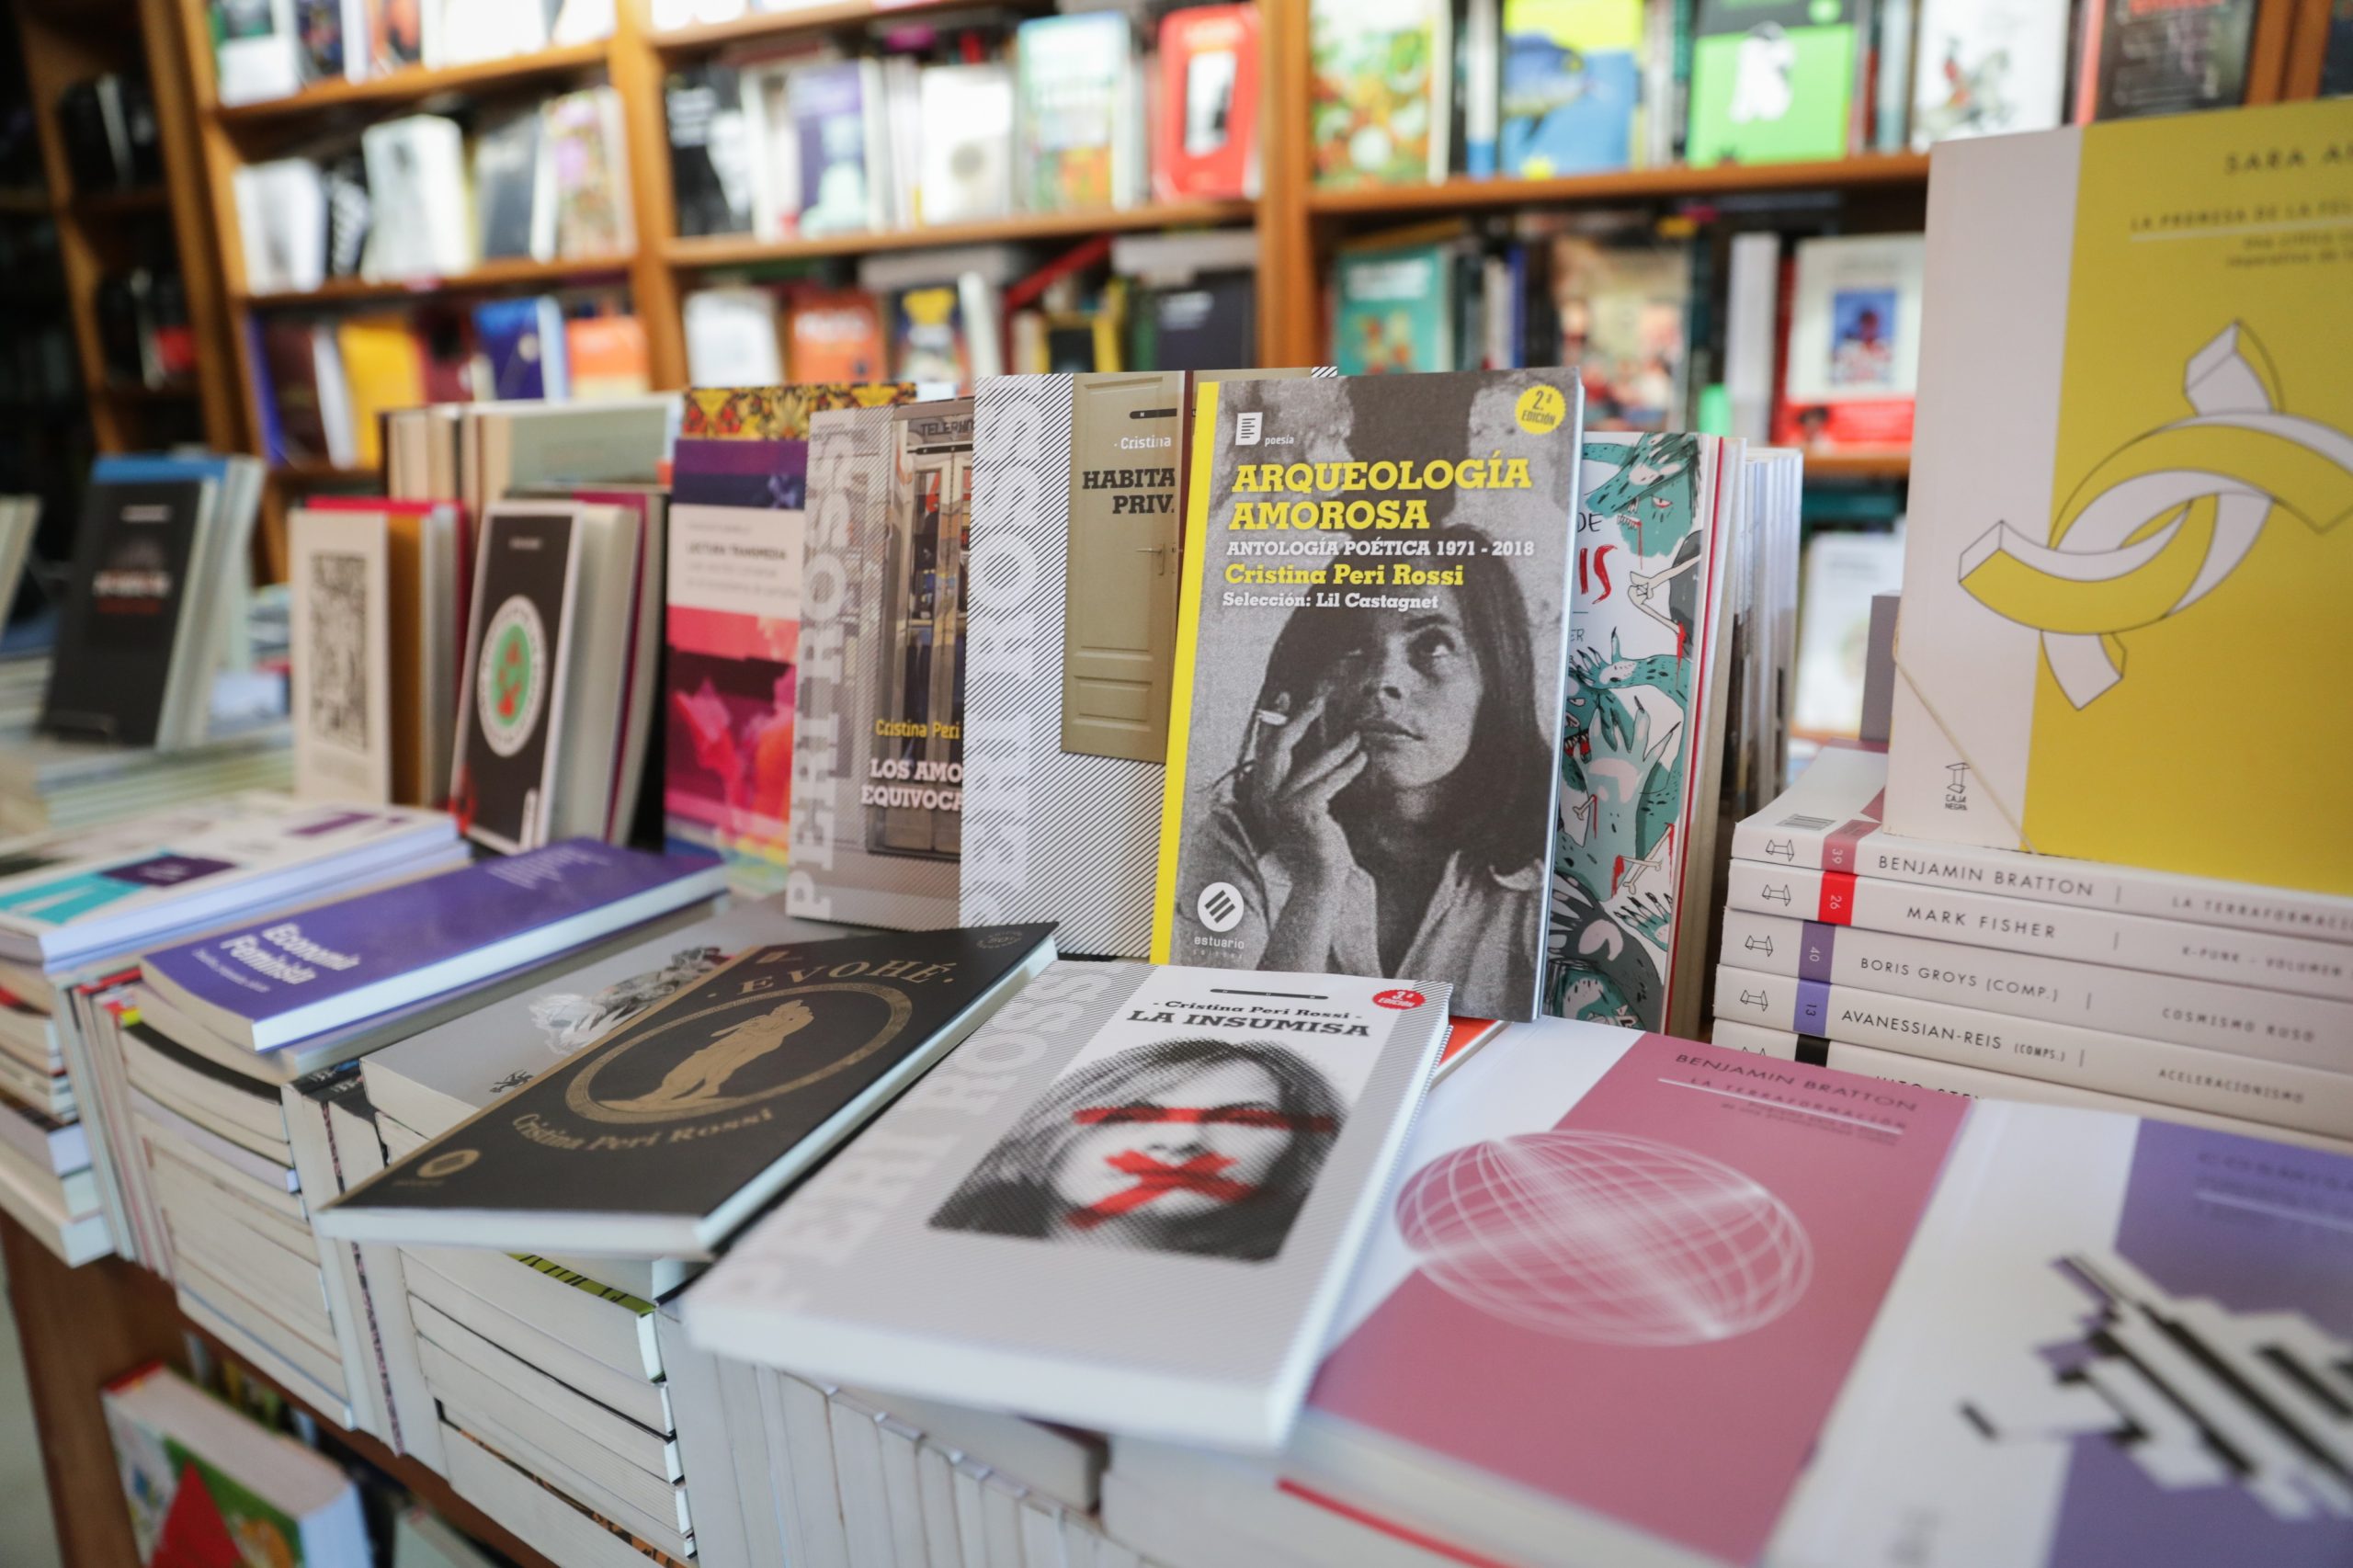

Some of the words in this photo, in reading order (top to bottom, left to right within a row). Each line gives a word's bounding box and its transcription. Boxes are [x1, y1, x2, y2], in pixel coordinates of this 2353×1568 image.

[2224, 147, 2306, 175] SARA
[1521, 410, 1556, 426] EDICIÓN
[1120, 435, 1172, 450] Cristina
[1264, 434, 1295, 448] poesía
[1082, 468, 1176, 490] HABITA
[1232, 449, 1532, 494] ARQUEOLOGÍA
[1112, 494, 1176, 515] PRIV
[1228, 499, 1430, 531] AMOROSA
[1226, 538, 1340, 556] ANTOLOGÍA
[1345, 537, 1431, 556] POÉTICA
[1437, 540, 1475, 556] 1971
[1493, 540, 1535, 556] 2018
[1224, 563, 1327, 585] Cristina
[1333, 563, 1385, 585] Peri
[1392, 563, 1464, 586] Rossi
[1222, 591, 1312, 608] Selección:
[1315, 592, 1339, 608] Lil
[1344, 592, 1438, 612] Castagnet
[875, 719, 927, 738] Cristina
[932, 721, 961, 740] Peri
[870, 757, 911, 780] LOS
[914, 760, 963, 783] AMO
[1945, 793, 1967, 802] CAJA
[786, 711, 841, 918] PERI
[1832, 847, 1844, 865] 39
[1879, 856, 1984, 882] BENJAMIN
[1994, 867, 2094, 897] BRATTON
[1830, 894, 1842, 910] 26
[2172, 897, 2192, 909] LA
[1907, 906, 1966, 927] MARK
[1980, 915, 2056, 939] FISHER
[1194, 935, 1245, 949] estuario
[1809, 947, 1820, 962] 40
[736, 960, 958, 996] EVOHÉ
[1860, 957, 1910, 976] BORIS
[1918, 967, 1977, 987] GROYS
[1986, 978, 2059, 1003] (COMP.)
[1165, 1000, 1244, 1013] Cristina
[1250, 1005, 1290, 1017] Peri
[1297, 1008, 1350, 1019] Rossi
[1805, 1003, 1817, 1017] 13
[1126, 1010, 1176, 1026] LA
[1182, 1013, 1370, 1038] INSUMISA
[2161, 1007, 2256, 1034] COSMISMO
[2265, 1024, 2316, 1044] RUSO
[1841, 1010, 2003, 1051] AVANESSIAN-REIS
[2014, 1042, 2067, 1062] (COMPS.)
[1675, 1054, 1796, 1085] BENJAMIN
[1802, 1080, 1918, 1112] BRATTON
[1690, 1077, 1711, 1088] LA
[2158, 1068, 2305, 1105] ACELERACIONISMO
[512, 1112, 588, 1150] Cristina
[585, 1131, 662, 1151] Peri
[669, 1107, 774, 1143] Rossi
